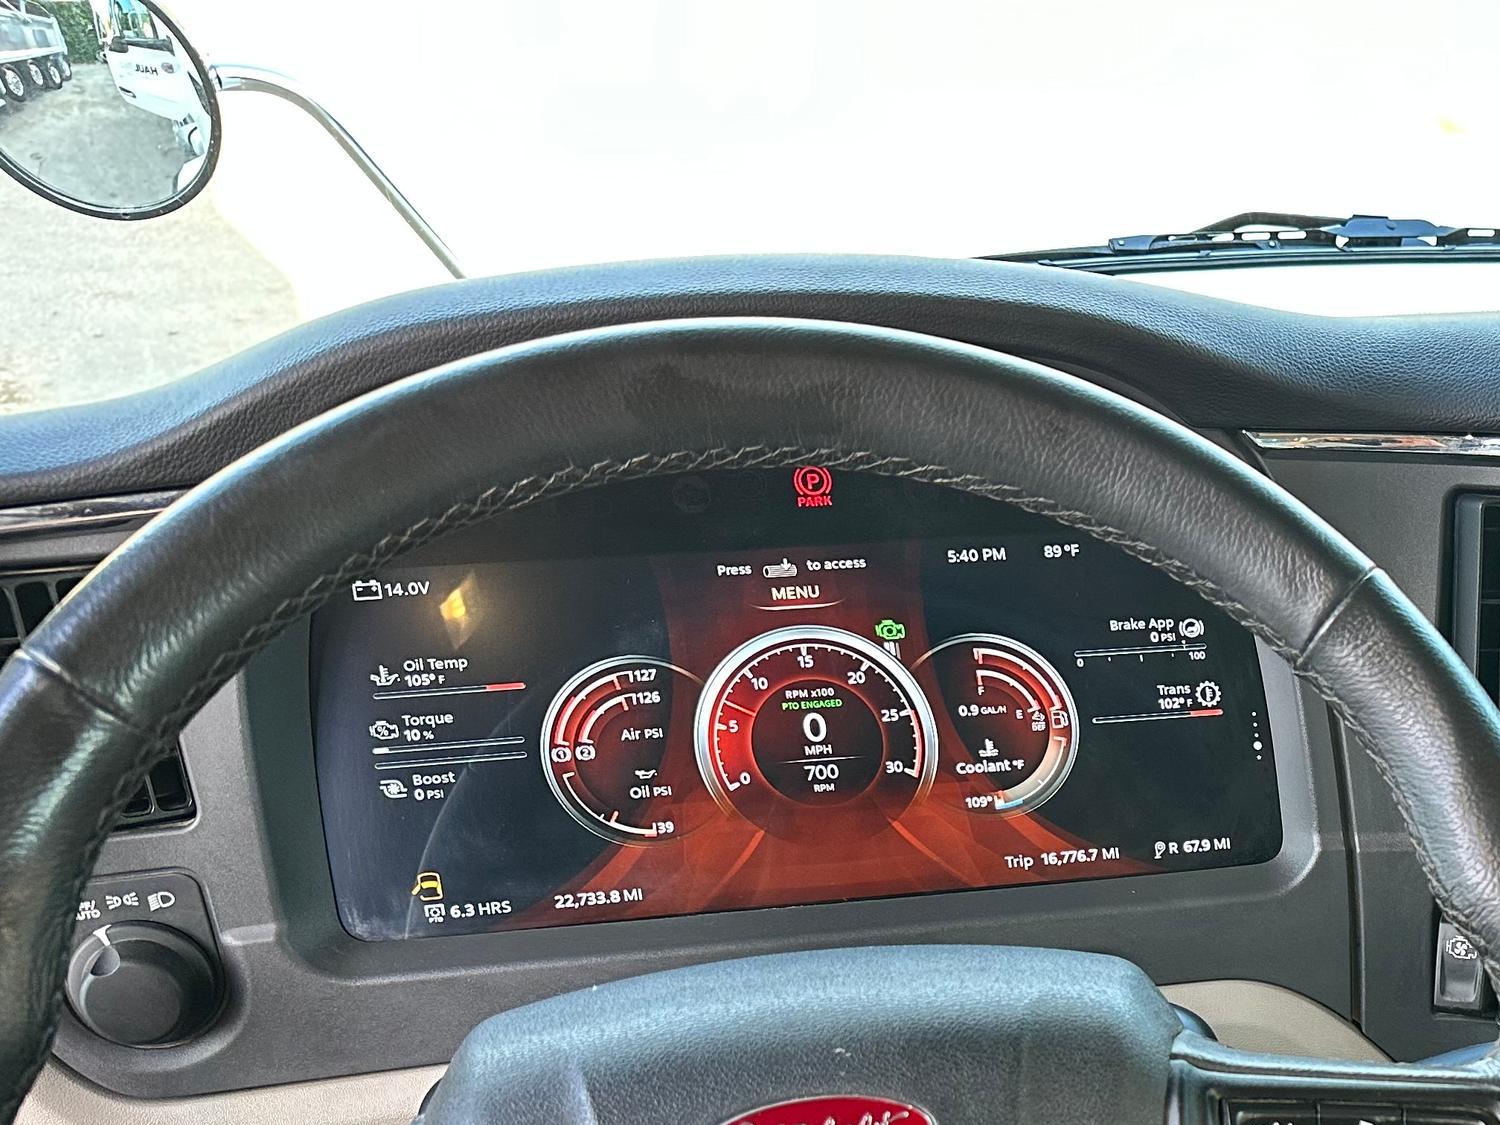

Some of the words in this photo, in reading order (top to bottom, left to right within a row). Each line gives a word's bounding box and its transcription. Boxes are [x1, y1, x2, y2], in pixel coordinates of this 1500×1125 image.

[797, 496, 833, 507] PARK
[947, 549, 979, 563] 5:40
[982, 548, 1007, 562] PM
[717, 564, 752, 577] Press
[806, 559, 822, 571] to
[824, 557, 867, 570] access
[384, 581, 430, 597] 14.0V
[771, 585, 820, 601] MENU
[1110, 618, 1145, 632] Brake
[1149, 618, 1175, 633] App
[1161, 632, 1176, 642] PSI
[403, 658, 423, 672] Oil
[427, 658, 468, 672] Temp
[797, 655, 814, 668] 15
[634, 669, 657, 682] 127
[847, 671, 866, 685] 20
[751, 677, 769, 690] 10
[1157, 684, 1191, 696] Trans
[638, 691, 661, 704] 126
[785, 689, 808, 700] RPM
[810, 687, 835, 698] x100
[782, 701, 800, 710] PTO
[801, 699, 843, 710] ENGAGED
[958, 704, 979, 717] 0.9
[980, 705, 1007, 715] GAL/H
[401, 713, 454, 728] Torque
[881, 709, 899, 722] 25
[803, 712, 827, 742] 0
[403, 729, 421, 742] 10
[621, 728, 641, 741] Air
[645, 728, 664, 739] PSI
[804, 744, 832, 756] MPH
[804, 763, 839, 781] 700
[886, 761, 903, 773] 30
[956, 760, 1011, 774] Coolant
[412, 771, 456, 786] Boost
[414, 788, 425, 801] 0
[426, 789, 444, 800] PSI
[630, 785, 650, 799] Oil
[653, 785, 672, 796] PSI
[813, 783, 835, 793] RPM
[657, 821, 675, 834] 39
[1183, 840, 1211, 853] 67.9
[1214, 838, 1231, 850] MI
[1004, 855, 1034, 869] Trip
[1040, 849, 1098, 866] 16,776.7
[1101, 847, 1120, 860] MI
[554, 890, 621, 909] 22,733.8
[623, 888, 643, 902] MI
[450, 904, 476, 919] 6.3
[478, 900, 512, 916] HRS
